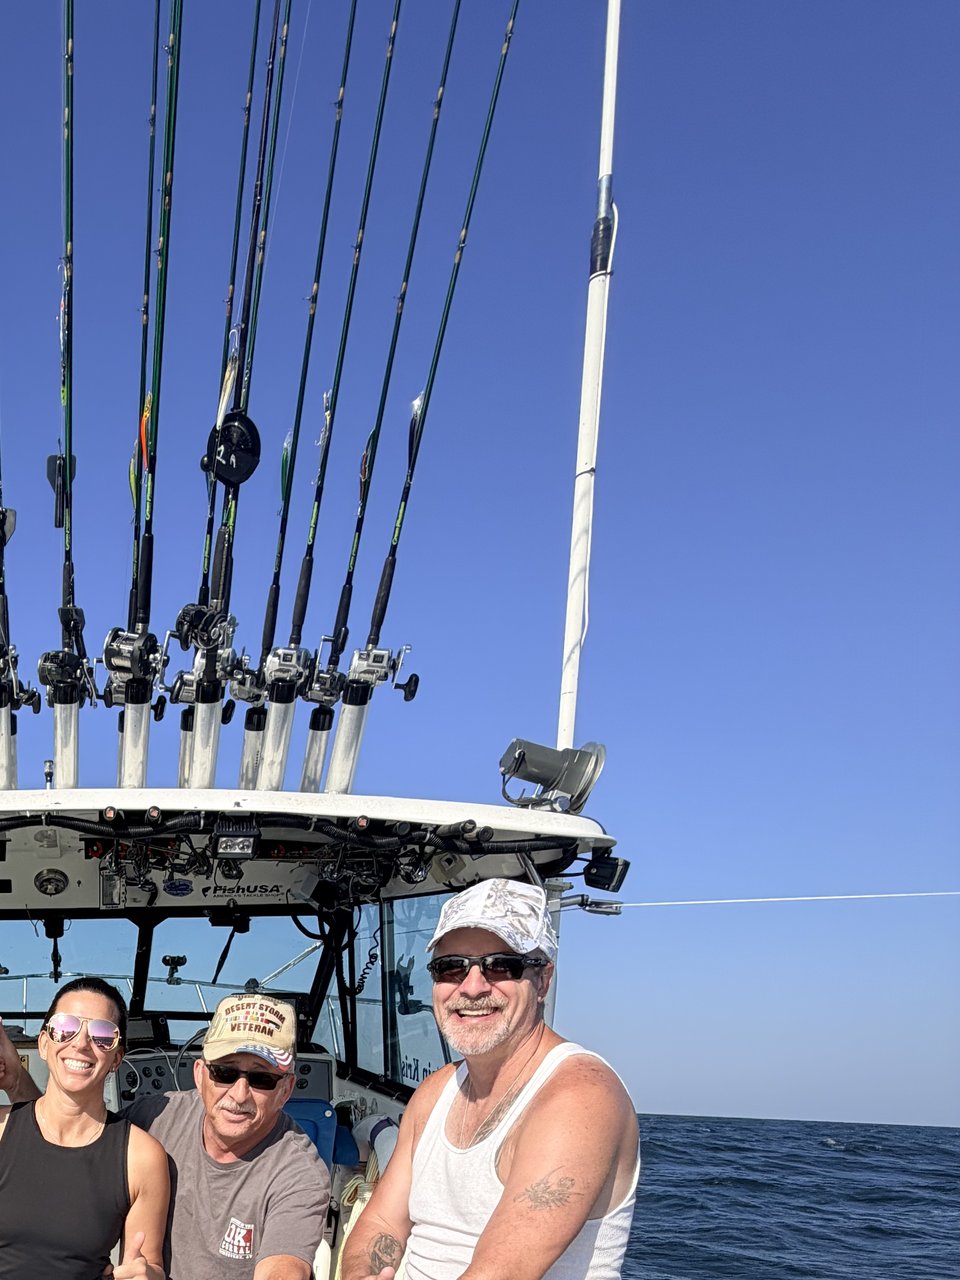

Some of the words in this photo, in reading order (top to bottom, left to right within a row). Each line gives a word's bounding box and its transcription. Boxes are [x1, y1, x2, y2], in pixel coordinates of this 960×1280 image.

[225, 1002, 257, 1016] DESERT
[258, 1003, 286, 1025] STORM
[230, 1022, 274, 1037] VETERAN
